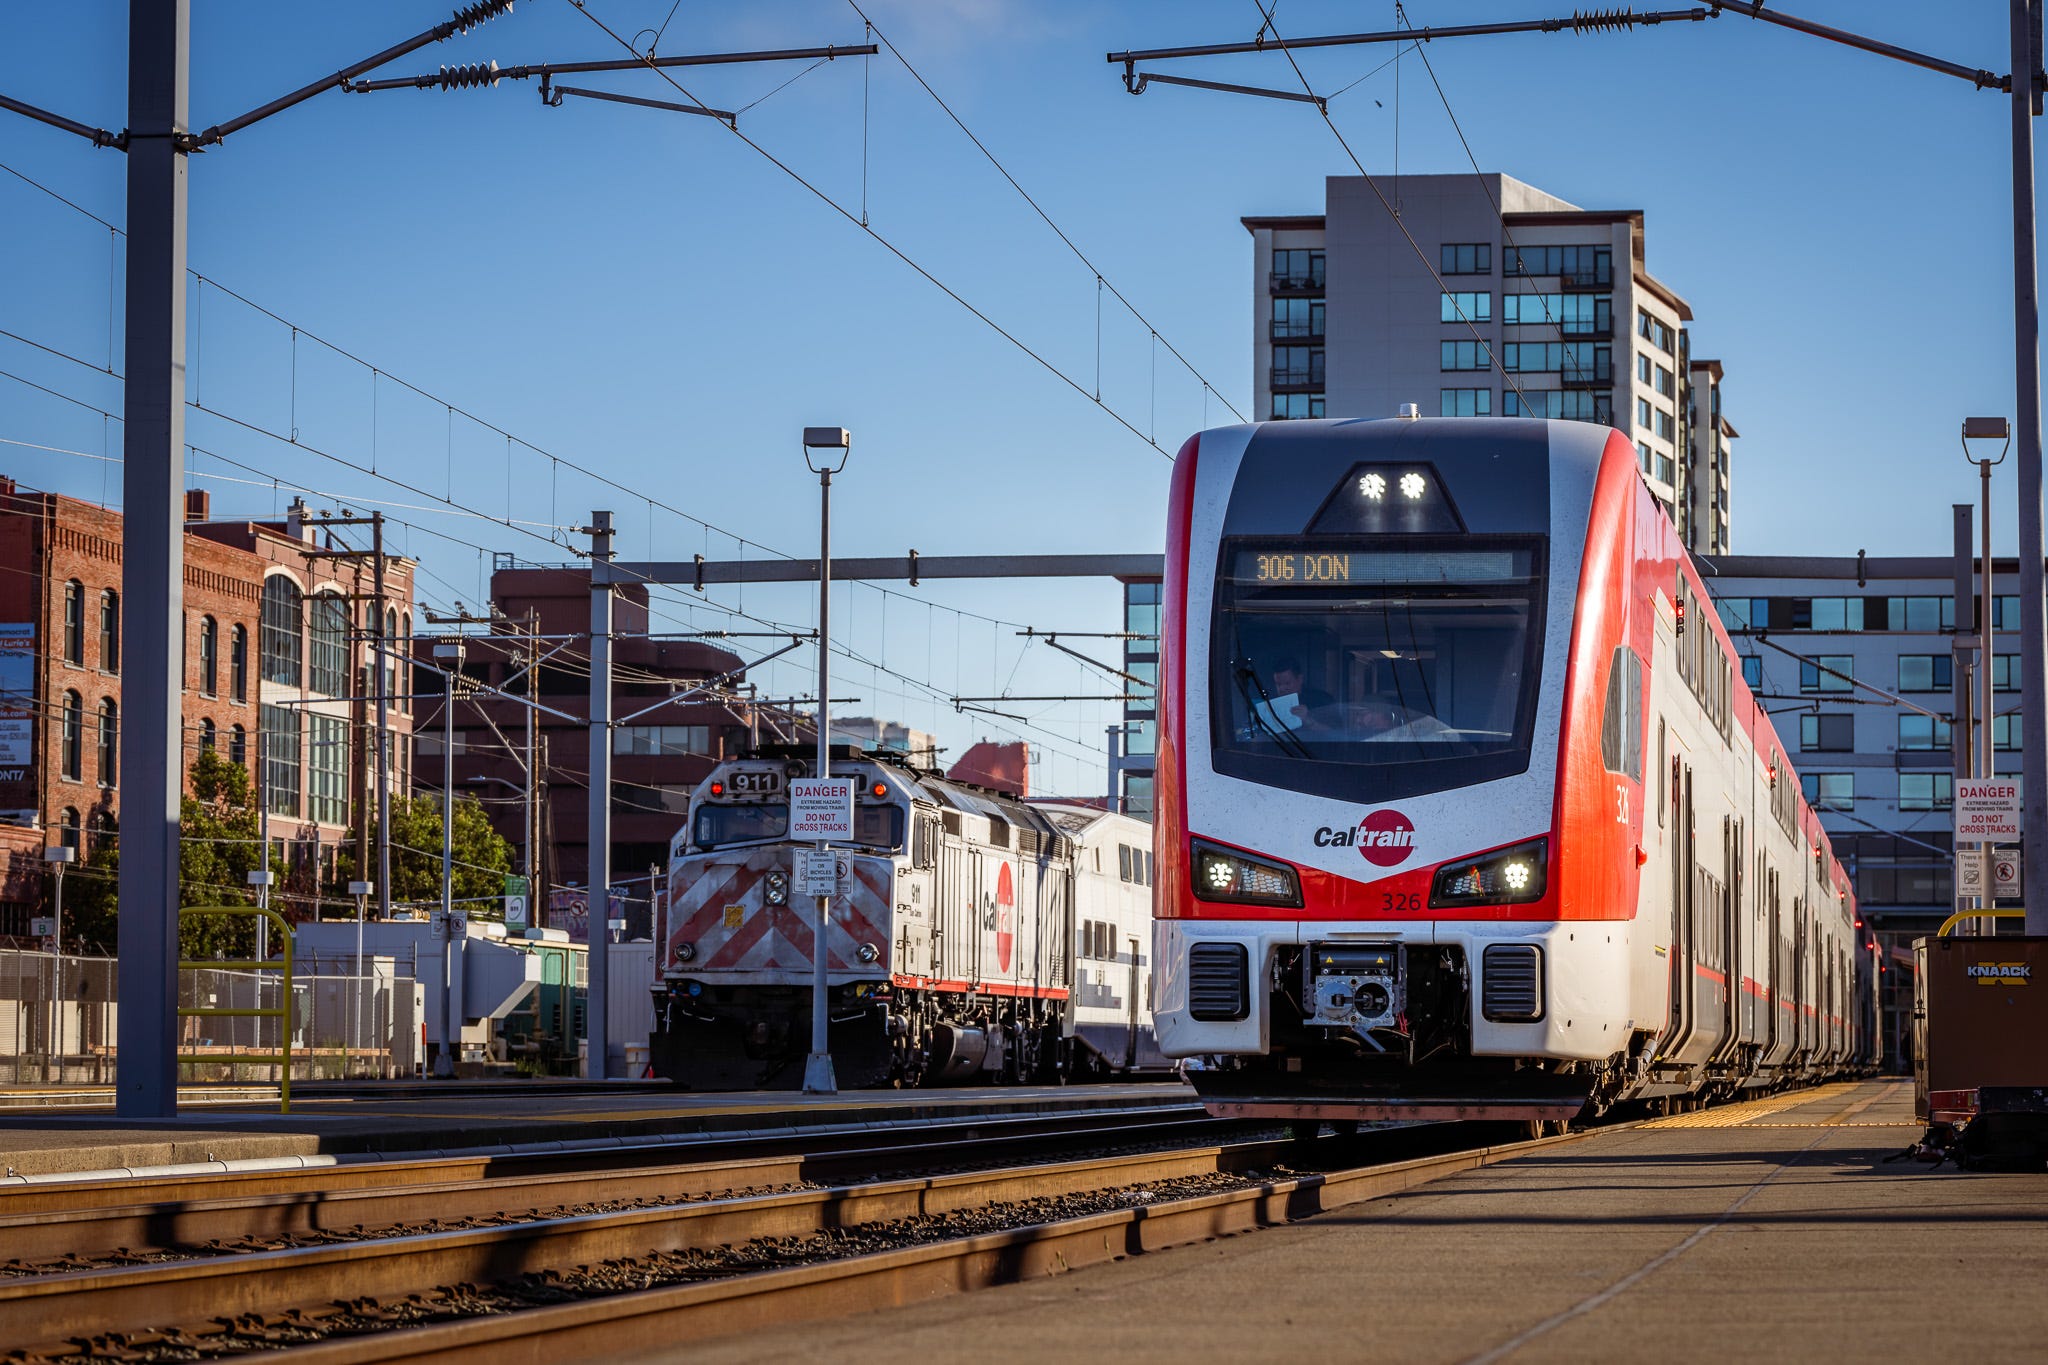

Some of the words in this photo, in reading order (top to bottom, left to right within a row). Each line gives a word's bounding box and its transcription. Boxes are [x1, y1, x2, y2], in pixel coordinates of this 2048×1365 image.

[1257, 554, 1295, 581] 306
[1304, 554, 1349, 581] DON
[736, 774, 772, 791] 911
[795, 786, 847, 797] DANGER
[1960, 786, 2015, 798] DANGER
[1616, 784, 1629, 825] 326
[805, 813, 818, 822] DO
[818, 813, 836, 822] NOT
[1971, 815, 1984, 823] DO
[1985, 815, 2004, 823] NOT
[794, 823, 819, 832] CROSS
[819, 823, 848, 832] TRACKS
[1960, 825, 1985, 834] CROSS
[1986, 825, 2016, 834] TRACKS
[1314, 826, 1416, 848] Caltrain
[911, 883, 921, 904] 911
[1382, 893, 1422, 911] 326
[1967, 966, 2031, 977] KNAACK
